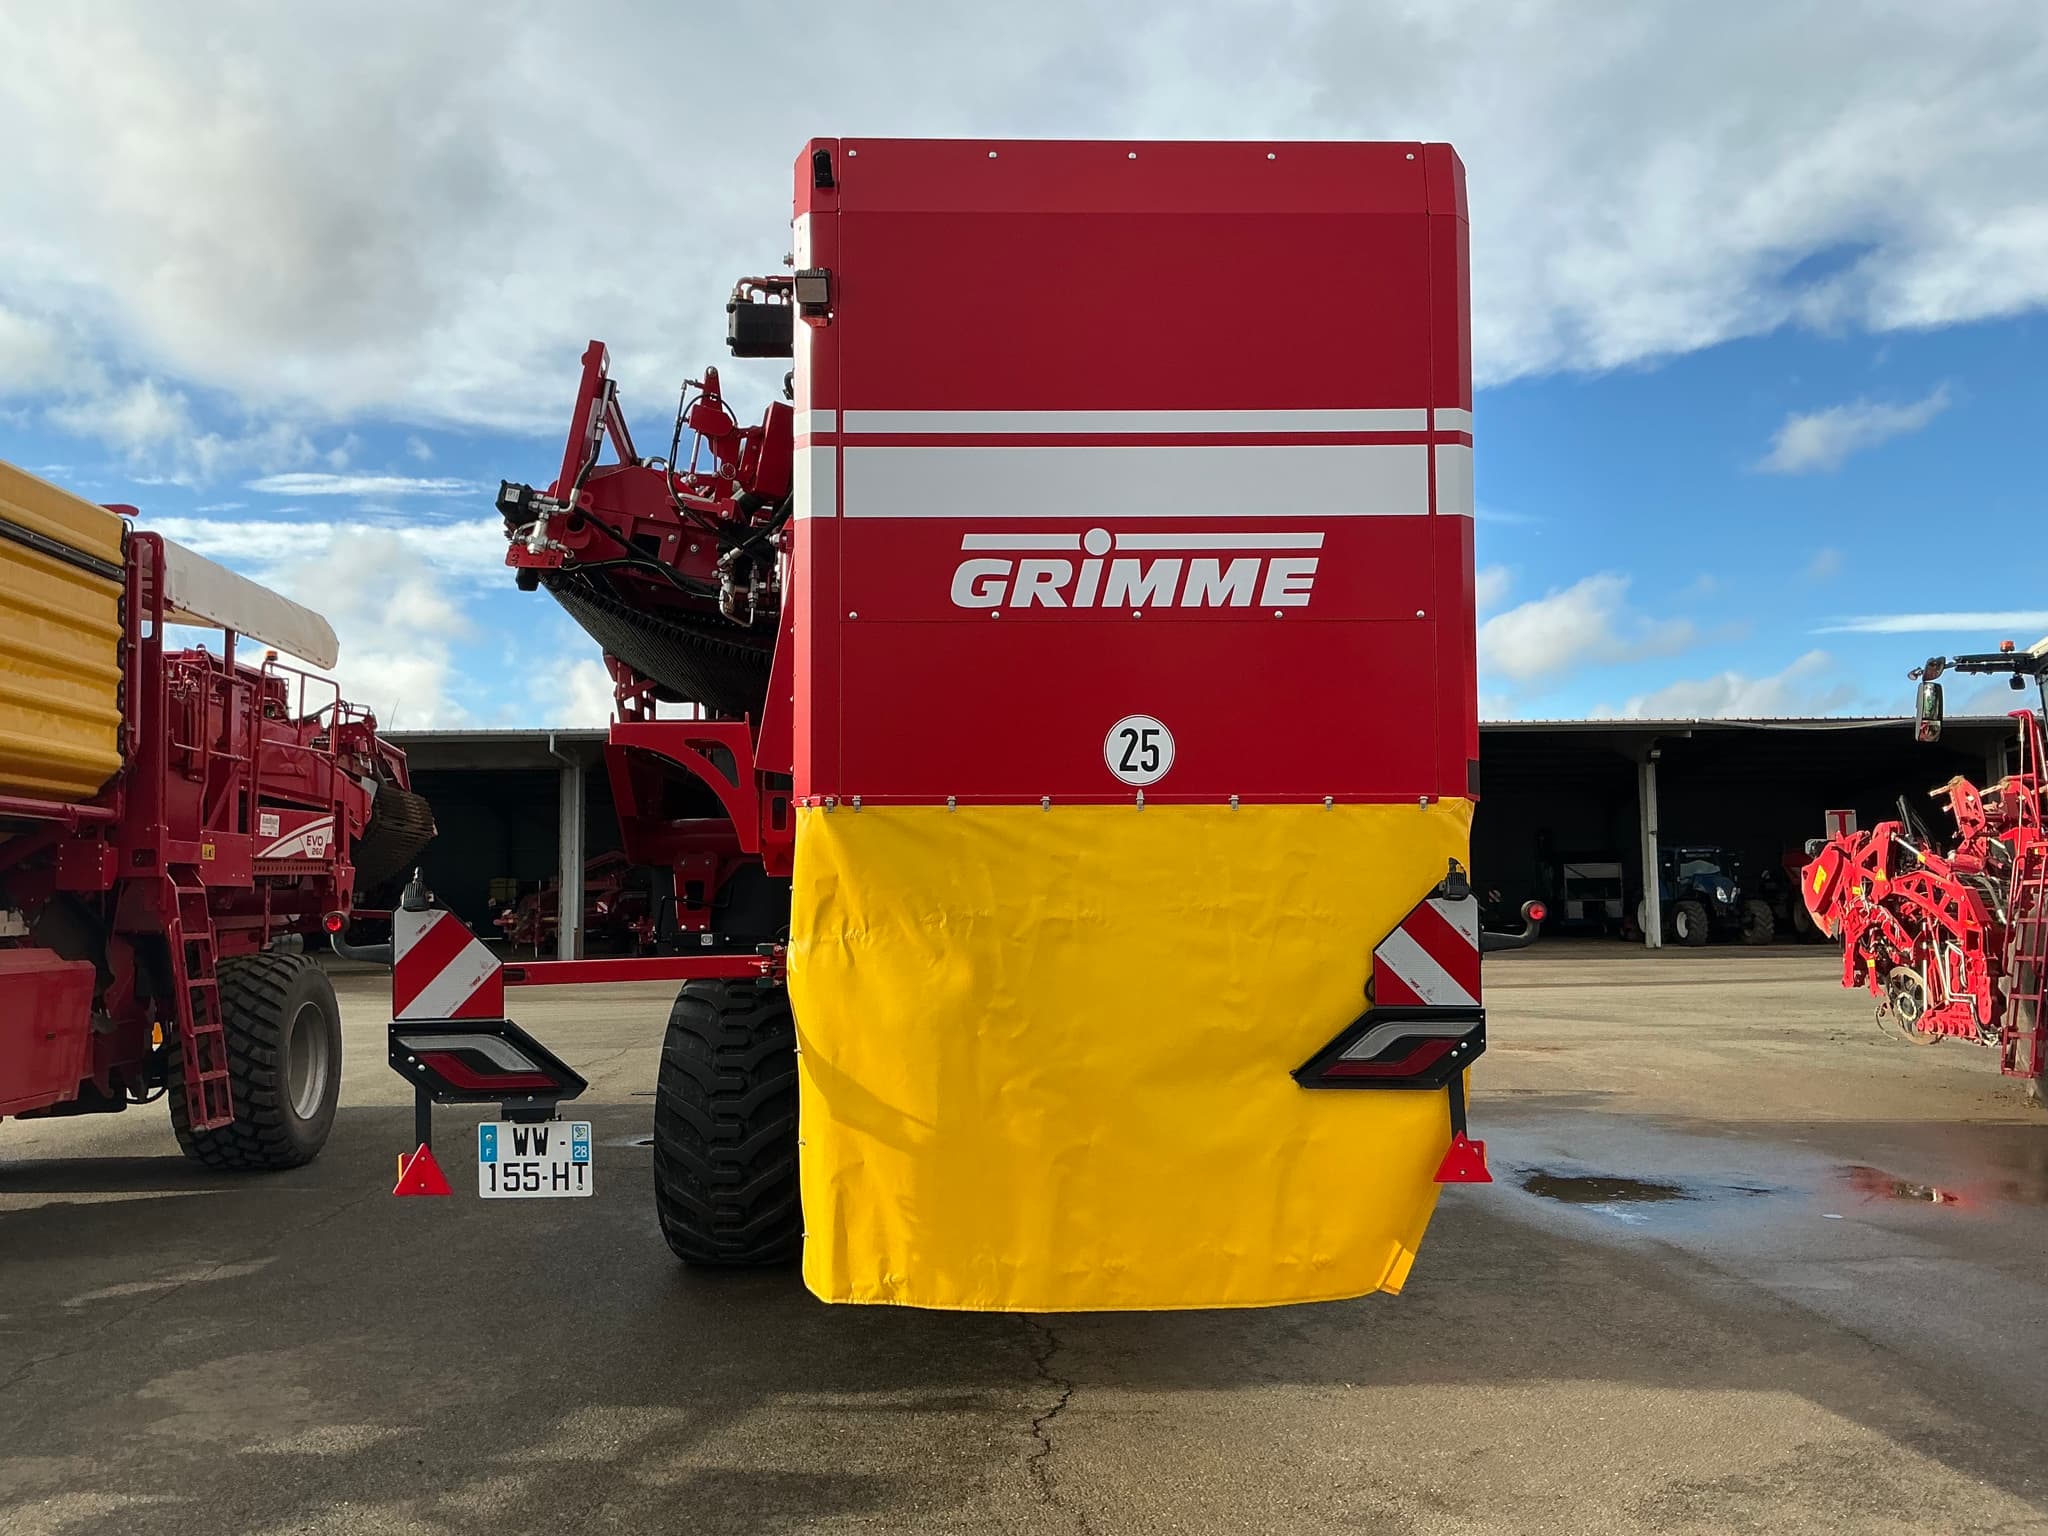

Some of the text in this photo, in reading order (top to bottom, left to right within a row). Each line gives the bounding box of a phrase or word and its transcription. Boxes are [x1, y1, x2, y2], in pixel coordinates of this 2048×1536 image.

[950, 551, 1320, 609] GRIMME
[1119, 728, 1160, 772] 25
[306, 835, 324, 846] EVO
[485, 1147, 493, 1157] F
[573, 1145, 587, 1159] 28
[488, 1162, 589, 1192] 155-HT
